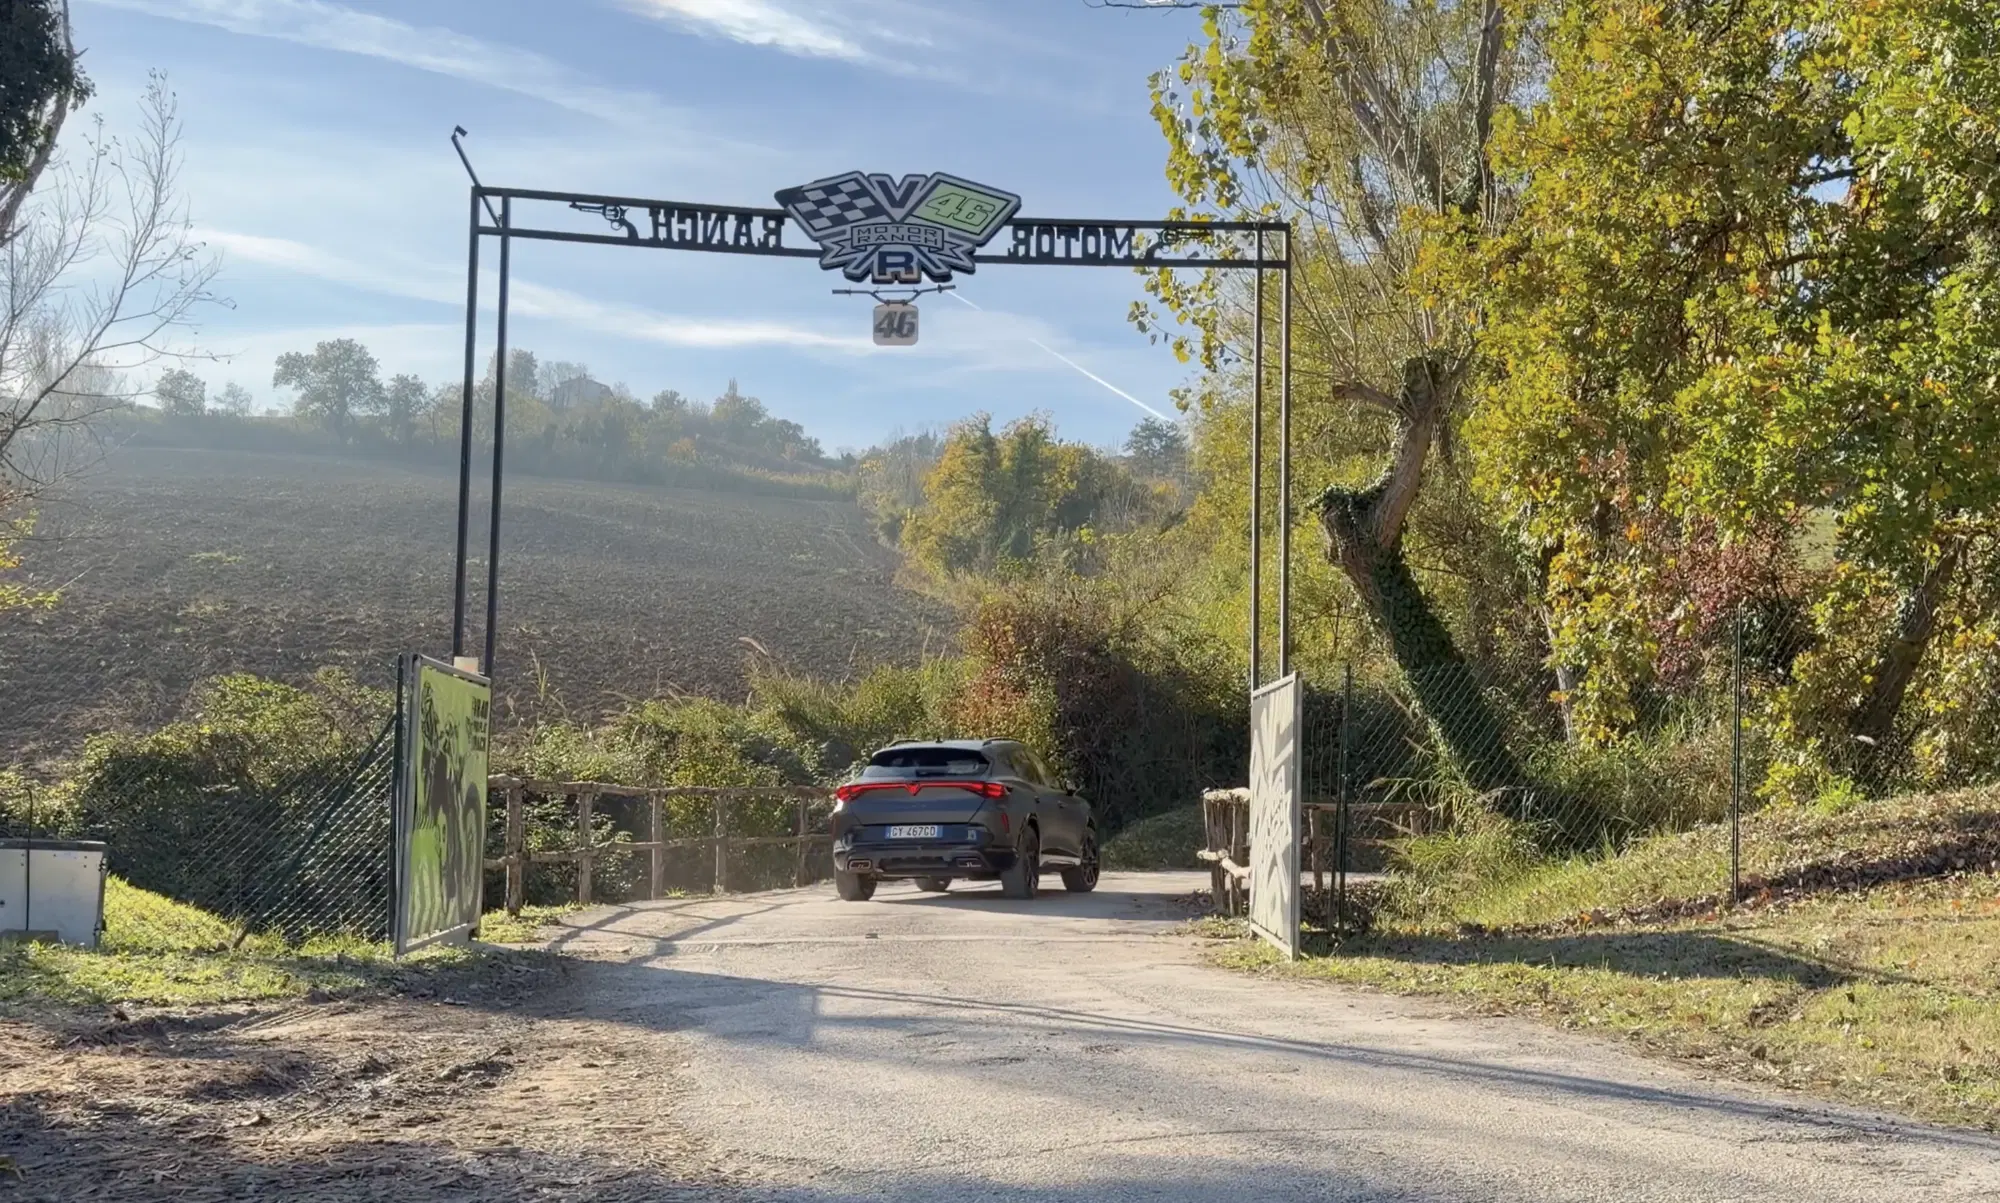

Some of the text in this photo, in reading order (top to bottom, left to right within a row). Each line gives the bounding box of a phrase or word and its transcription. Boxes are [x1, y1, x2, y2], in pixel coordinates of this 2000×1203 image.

[871, 177, 996, 227] V 46
[857, 225, 938, 237] MOTOR
[857, 234, 938, 246] RANCH
[876, 250, 916, 278] R
[875, 311, 916, 339] 46
